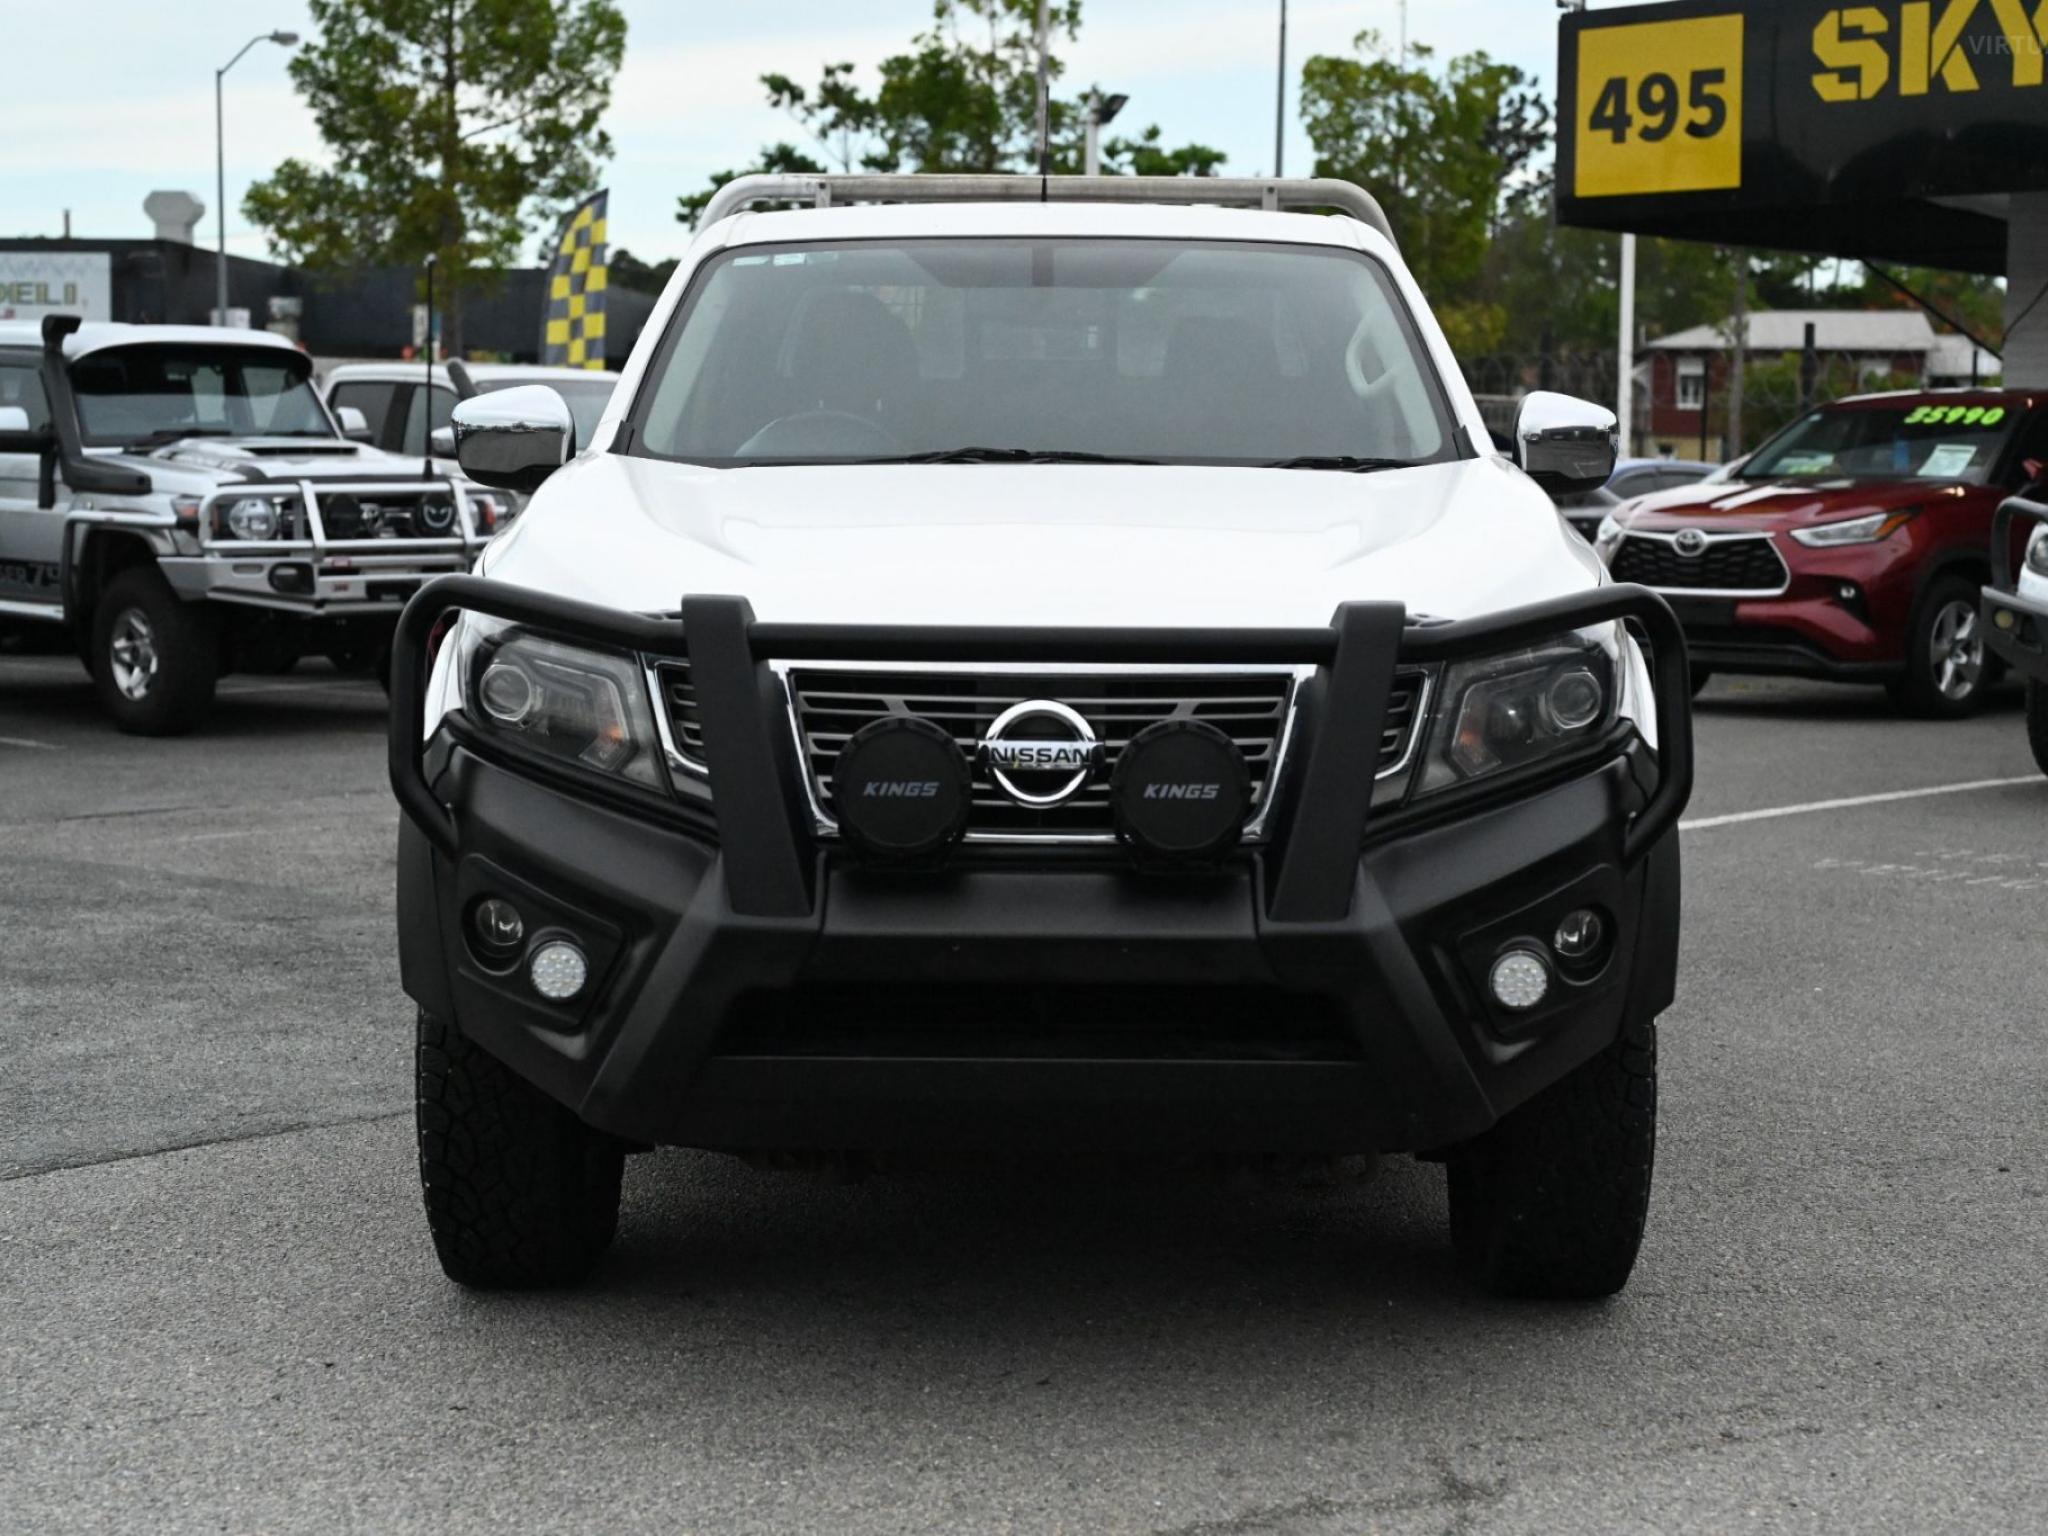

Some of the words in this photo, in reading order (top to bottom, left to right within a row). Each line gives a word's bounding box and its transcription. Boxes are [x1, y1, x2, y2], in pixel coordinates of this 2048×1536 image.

[1589, 67, 1727, 144] 495
[990, 747, 1090, 764] NISSAN
[863, 781, 940, 797] KINGS
[1143, 783, 1220, 799] KINGS
